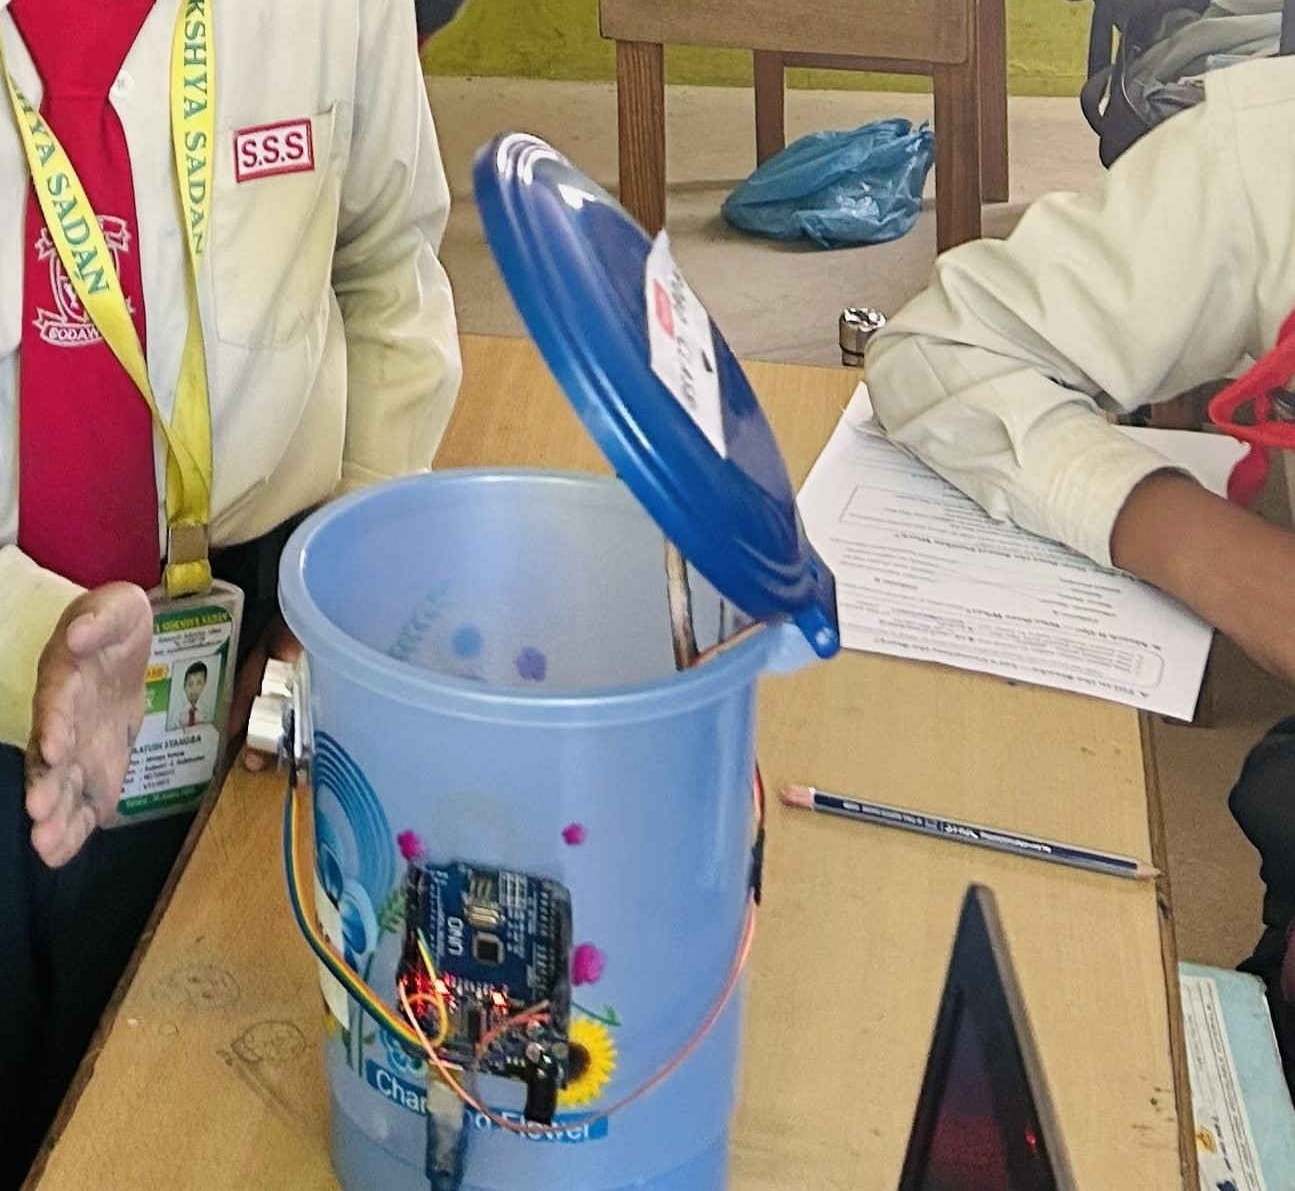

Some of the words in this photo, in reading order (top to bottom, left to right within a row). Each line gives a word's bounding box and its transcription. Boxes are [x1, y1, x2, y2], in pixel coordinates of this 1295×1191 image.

[46, 172, 110, 295] SADAN
[184, 129, 208, 256] SADAN
[447, 916, 464, 956] UNO
